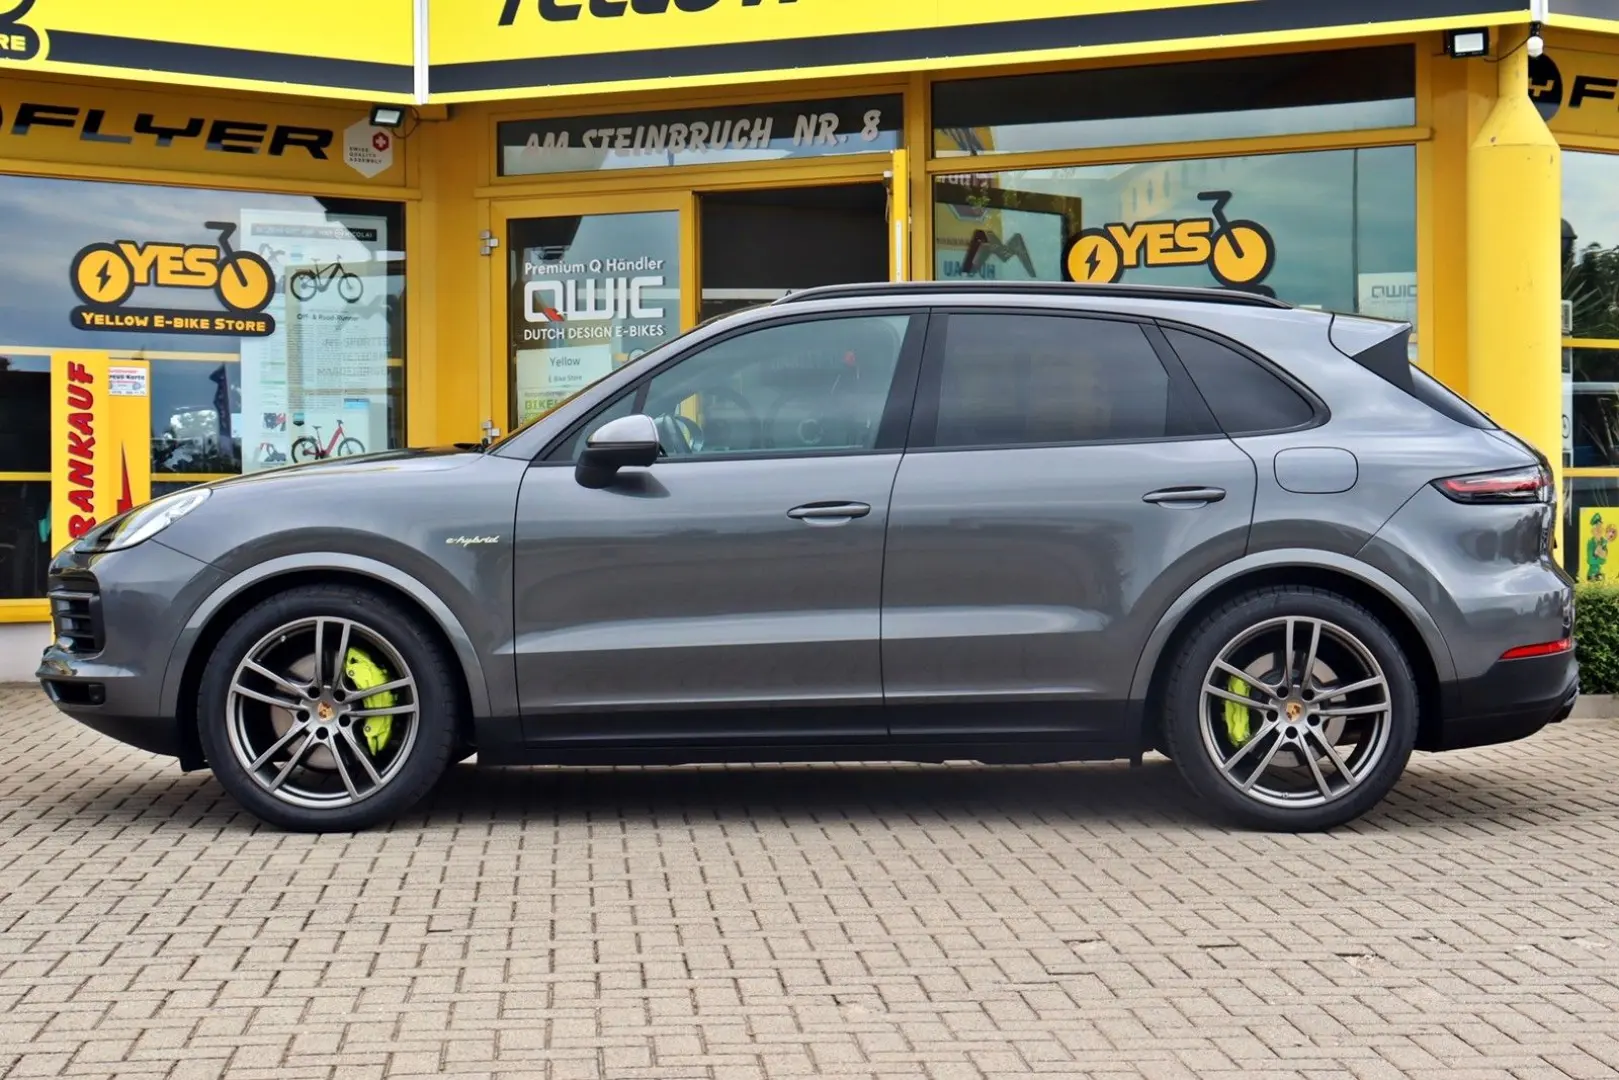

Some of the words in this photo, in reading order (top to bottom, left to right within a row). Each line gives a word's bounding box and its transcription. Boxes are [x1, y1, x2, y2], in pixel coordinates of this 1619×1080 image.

[10, 102, 334, 160] FLYER
[521, 131, 569, 157] AM
[581, 116, 774, 158] STEINBRUCH
[792, 112, 849, 148] NR.
[861, 109, 882, 142] 8
[1106, 220, 1212, 266] YES
[117, 242, 220, 288] YES
[524, 262, 585, 275] Premium
[589, 259, 603, 272] Q
[606, 256, 663, 272] Händler
[524, 276, 663, 322] QWIC
[81, 312, 149, 327] YELLOW
[153, 315, 210, 330] E-BIKE
[214, 317, 266, 332] STORE
[524, 328, 565, 341] DUTCH
[568, 325, 613, 339] DESIGN
[615, 323, 664, 337] E-BIKES
[549, 356, 581, 367] Yellow
[445, 535, 500, 548] e-hybrid
